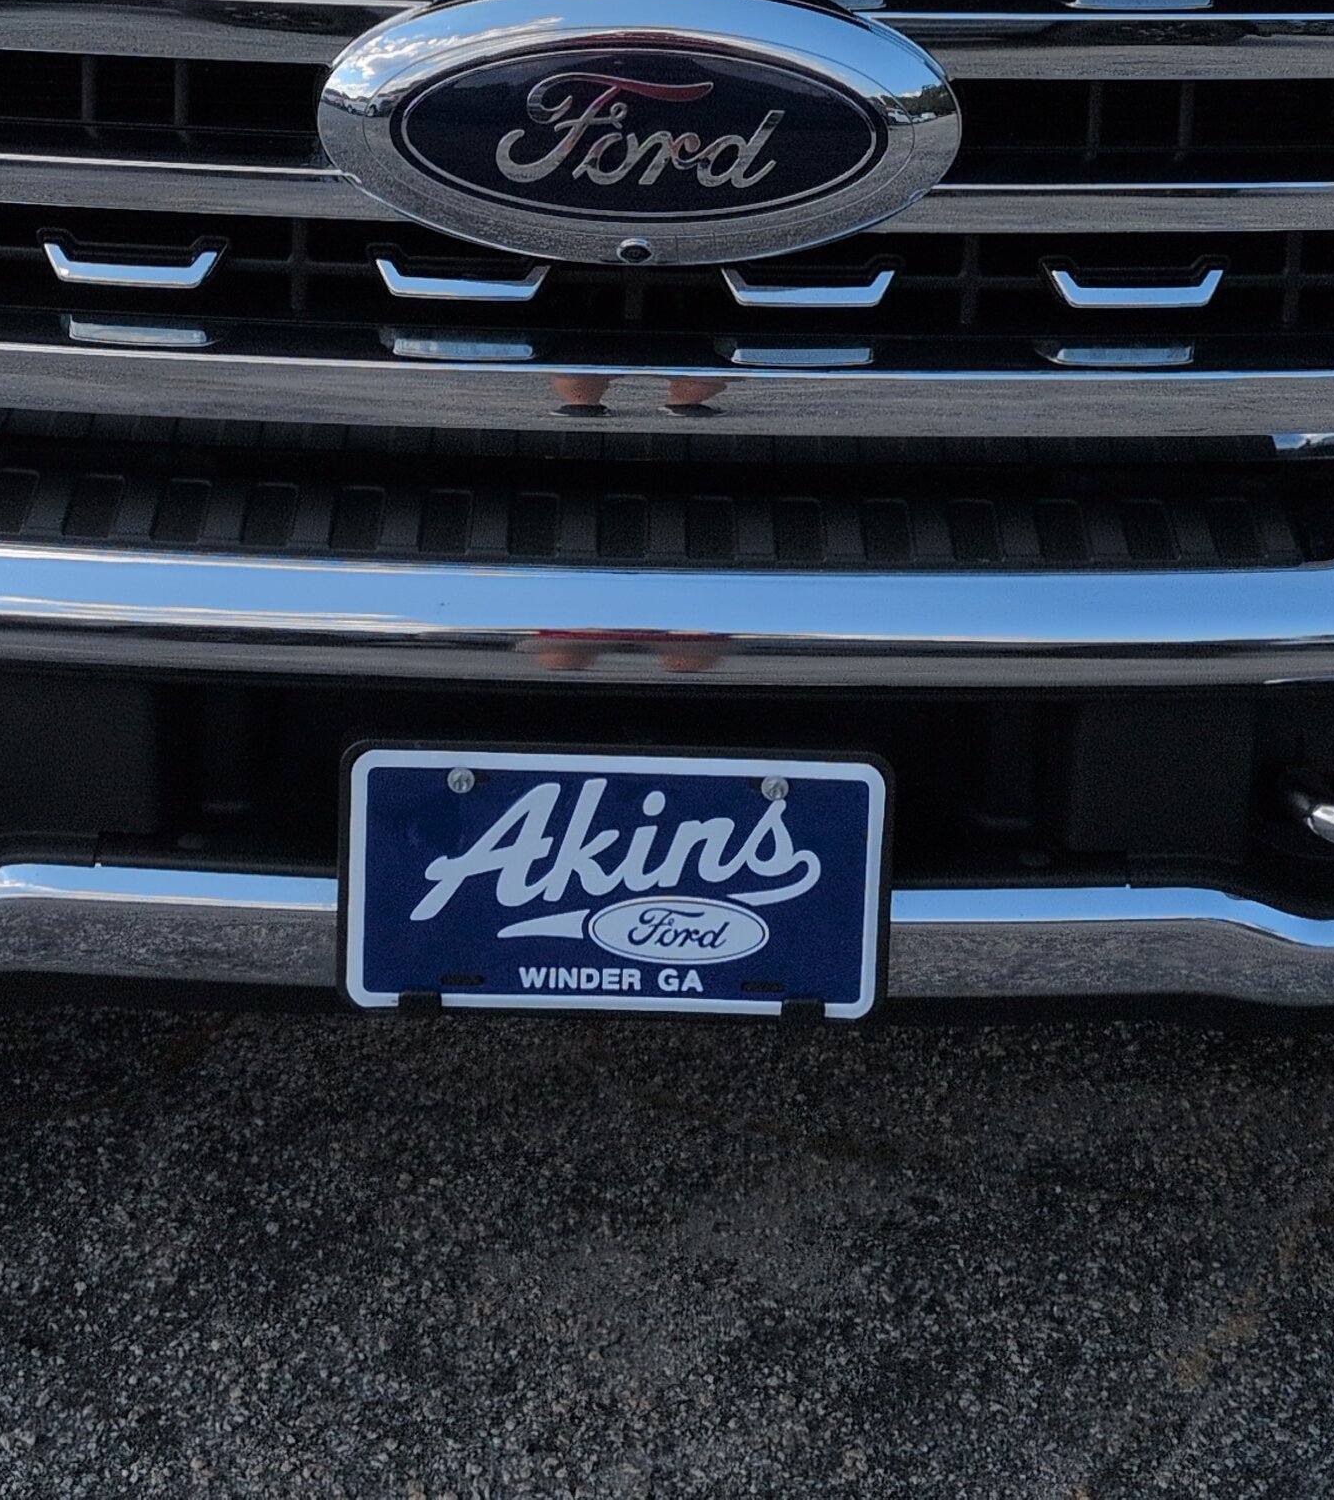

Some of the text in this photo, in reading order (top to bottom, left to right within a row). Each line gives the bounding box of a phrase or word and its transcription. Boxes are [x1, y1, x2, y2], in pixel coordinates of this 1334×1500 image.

[495, 71, 785, 189] Ford
[409, 777, 821, 921] Akins
[627, 906, 727, 950] Ford
[518, 966, 704, 993] WINDER GA
